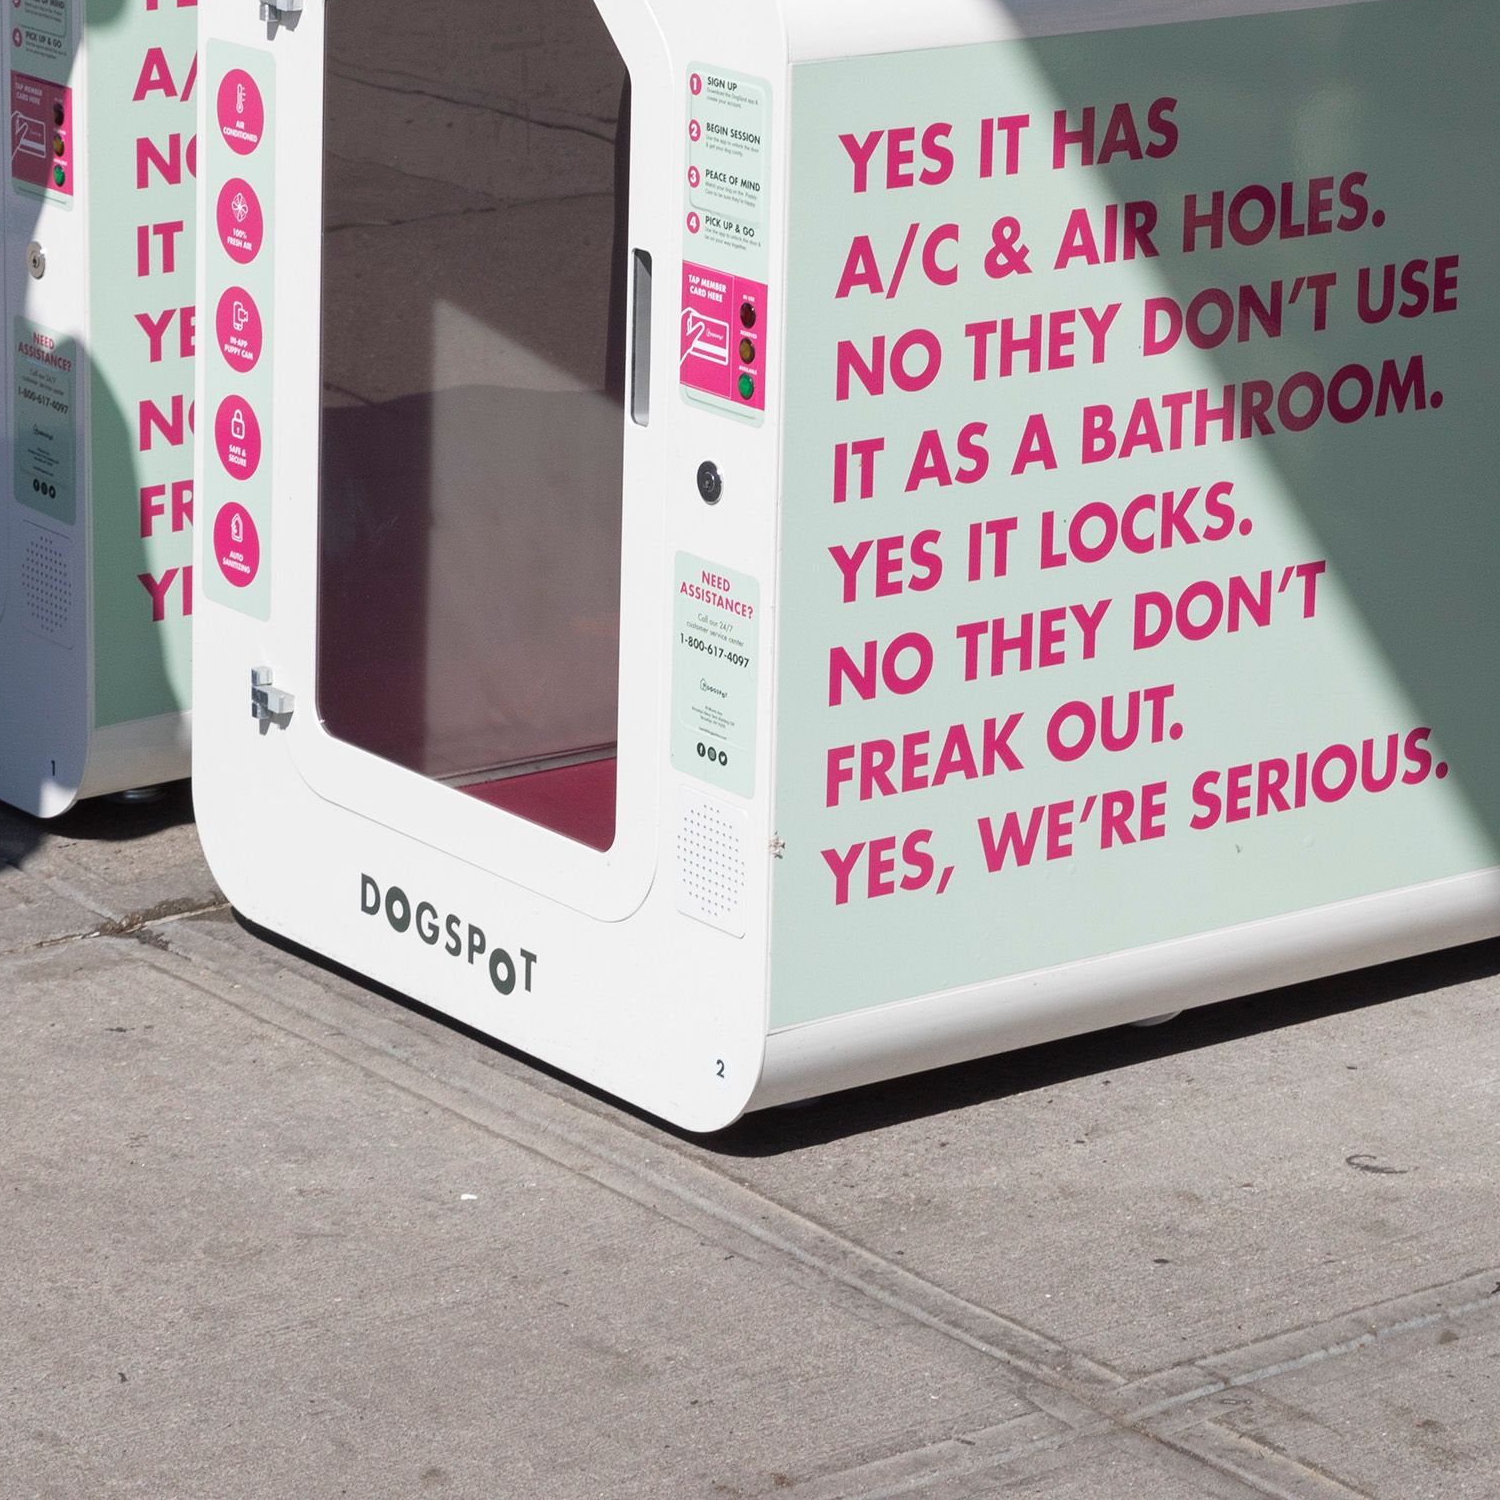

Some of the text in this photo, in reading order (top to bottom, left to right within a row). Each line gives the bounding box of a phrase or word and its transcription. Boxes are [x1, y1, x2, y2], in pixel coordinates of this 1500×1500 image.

[707, 76, 726, 89] SIGN
[727, 81, 738, 91] UP
[706, 121, 728, 136] BEGIN
[730, 128, 761, 146] SESSION
[838, 98, 1179, 194] YES IT HAS
[136, 133, 197, 190] N
[705, 168, 727, 183] PEACE
[728, 175, 739, 186] OF
[740, 178, 761, 192] MIND
[232, 228, 247, 239] 100%
[705, 215, 721, 229] PICK
[723, 221, 733, 231] UP
[742, 226, 755, 237] GO
[835, 171, 1387, 300] A/C & AIR HOLES.
[137, 220, 185, 277] IT
[688, 274, 727, 293] TAP MEMBER
[689, 285, 723, 303] CARD HERE
[33, 332, 54, 350] NEED
[835, 255, 1459, 402] NO THEY DON'T USE
[18, 342, 72, 372] ASSISTANCE?
[224, 344, 240, 356] PUPPY
[139, 394, 195, 452] N
[833, 354, 1444, 504] IT AS A BATHROOM.
[828, 481, 1253, 604] YES IT LOCKS.
[701, 570, 730, 592] NEED
[680, 581, 753, 619] ASSISTANCE?
[680, 632, 750, 668] 1-800-617-4097
[828, 560, 1326, 707] NO THEY DON'T
[825, 683, 1184, 808] FREAK OUT.
[821, 727, 1450, 906] YES, WE'RE SERIOUS.
[360, 872, 538, 996] DOGSPOT
[716, 1059, 726, 1079] 2
